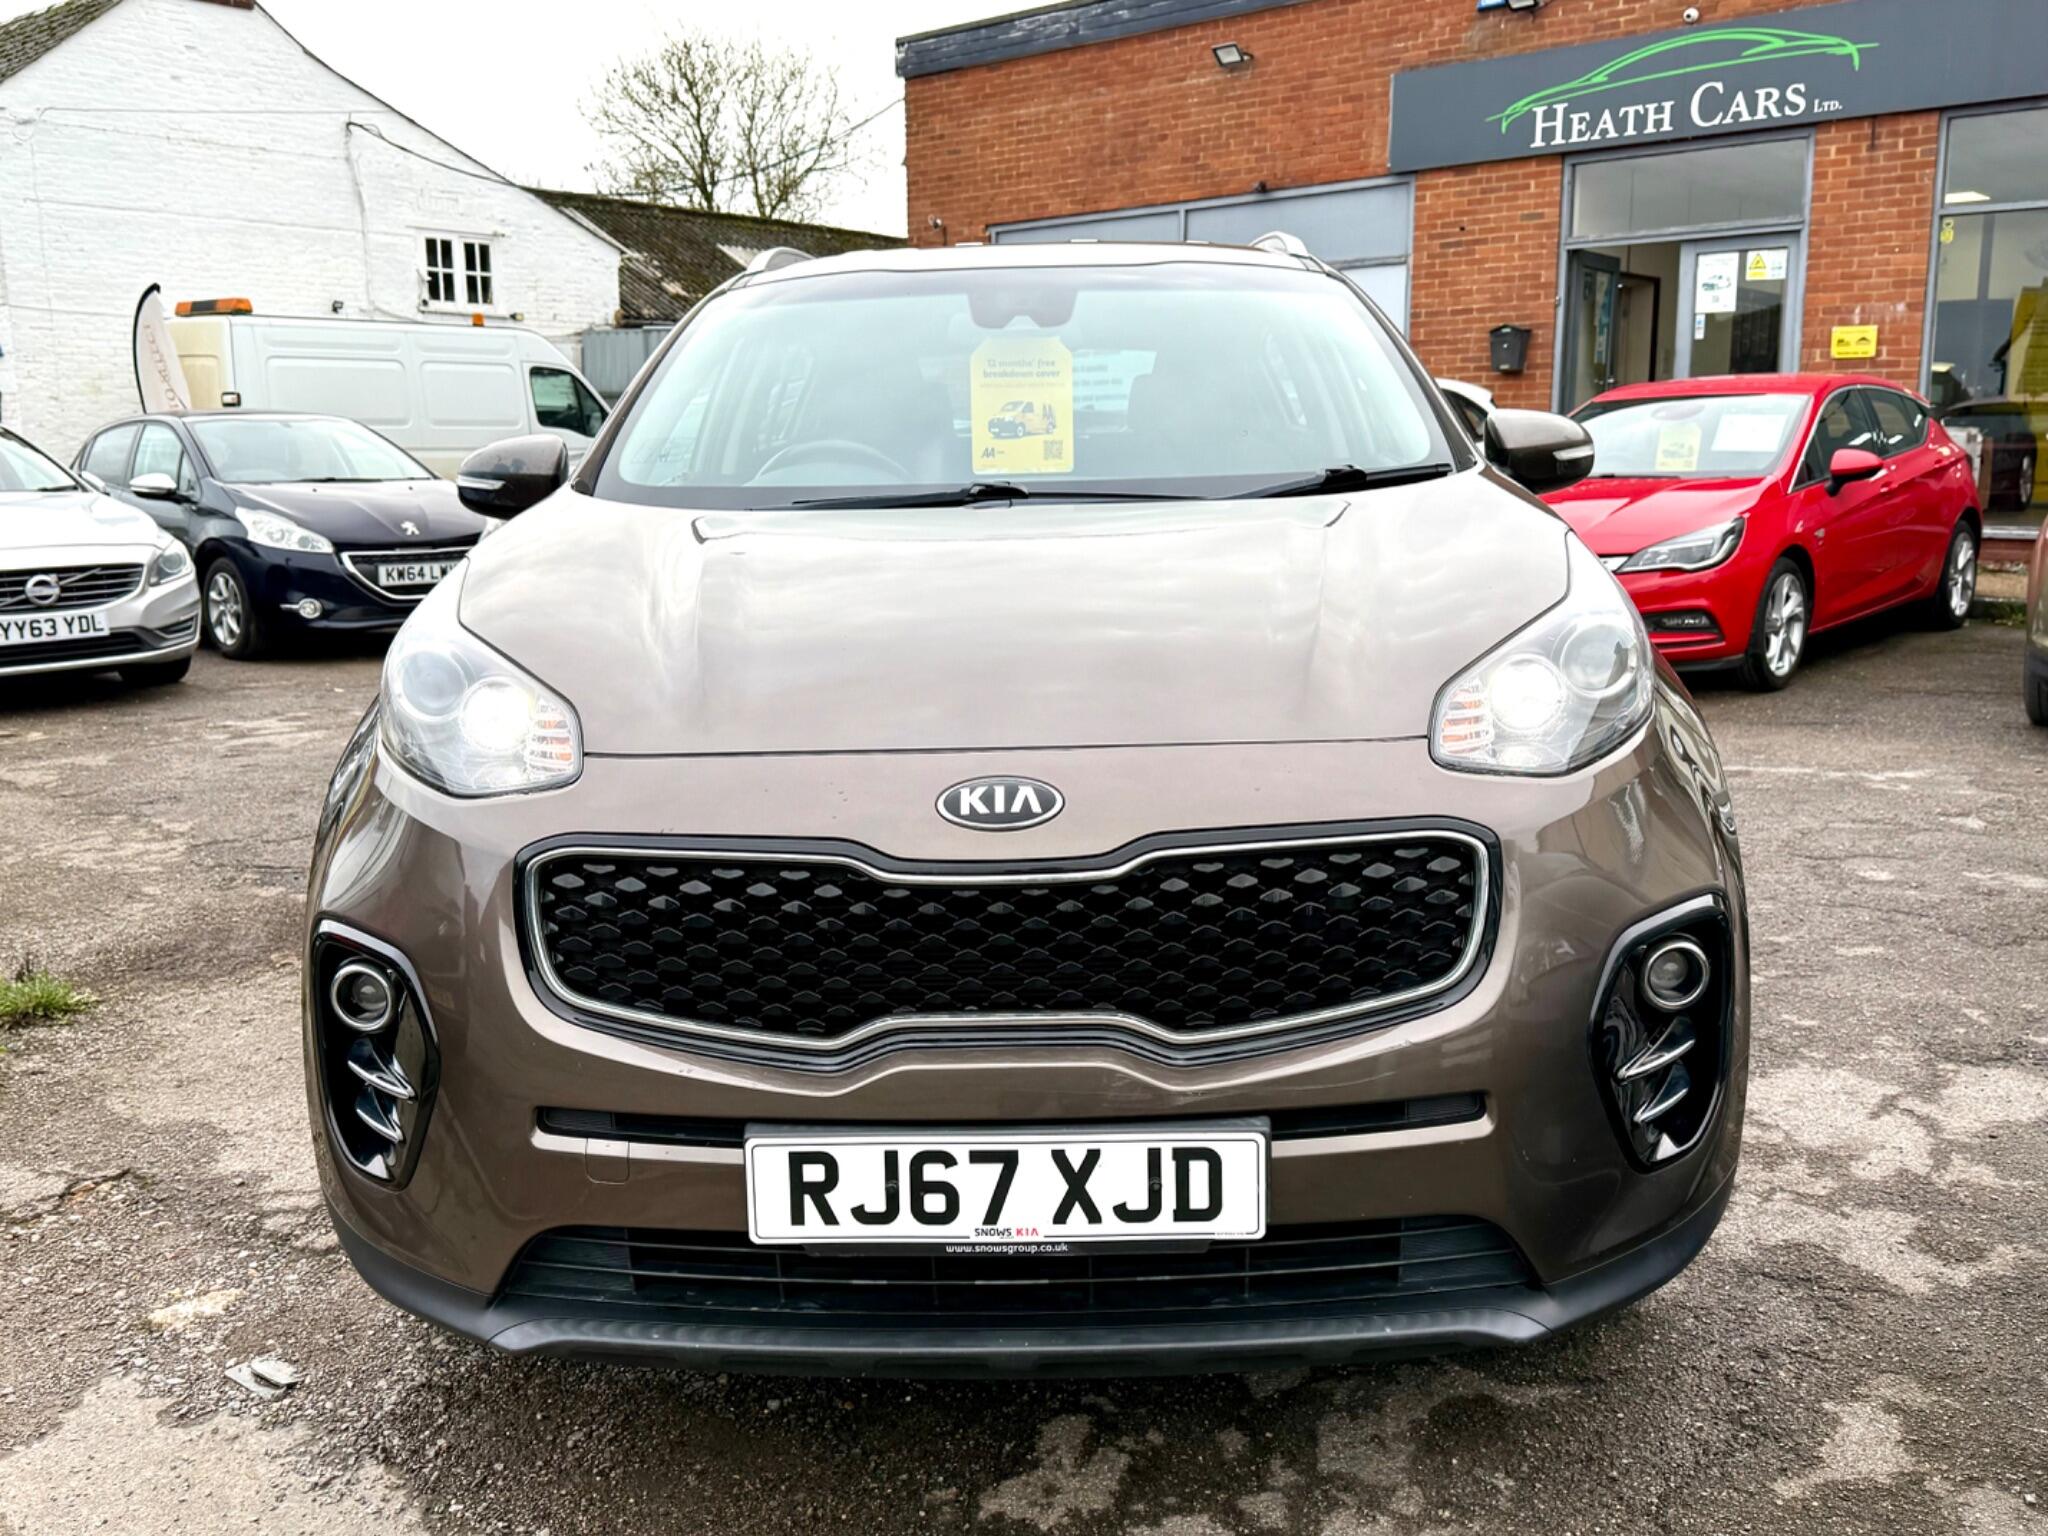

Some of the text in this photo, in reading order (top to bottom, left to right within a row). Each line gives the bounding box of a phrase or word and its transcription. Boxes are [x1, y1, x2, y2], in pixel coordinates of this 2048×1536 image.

[1529, 101, 1675, 148] HEATH
[1690, 81, 1807, 127] CARS
[385, 565, 425, 582] KW64
[0, 614, 104, 640] YY63 YDL
[959, 785, 1042, 816] KIA
[788, 1146, 1224, 1226] RJ67 XJD
[974, 1228, 1038, 1237] SNOWS KIA
[945, 1243, 1068, 1255] www.snowsgroup.co.uk
